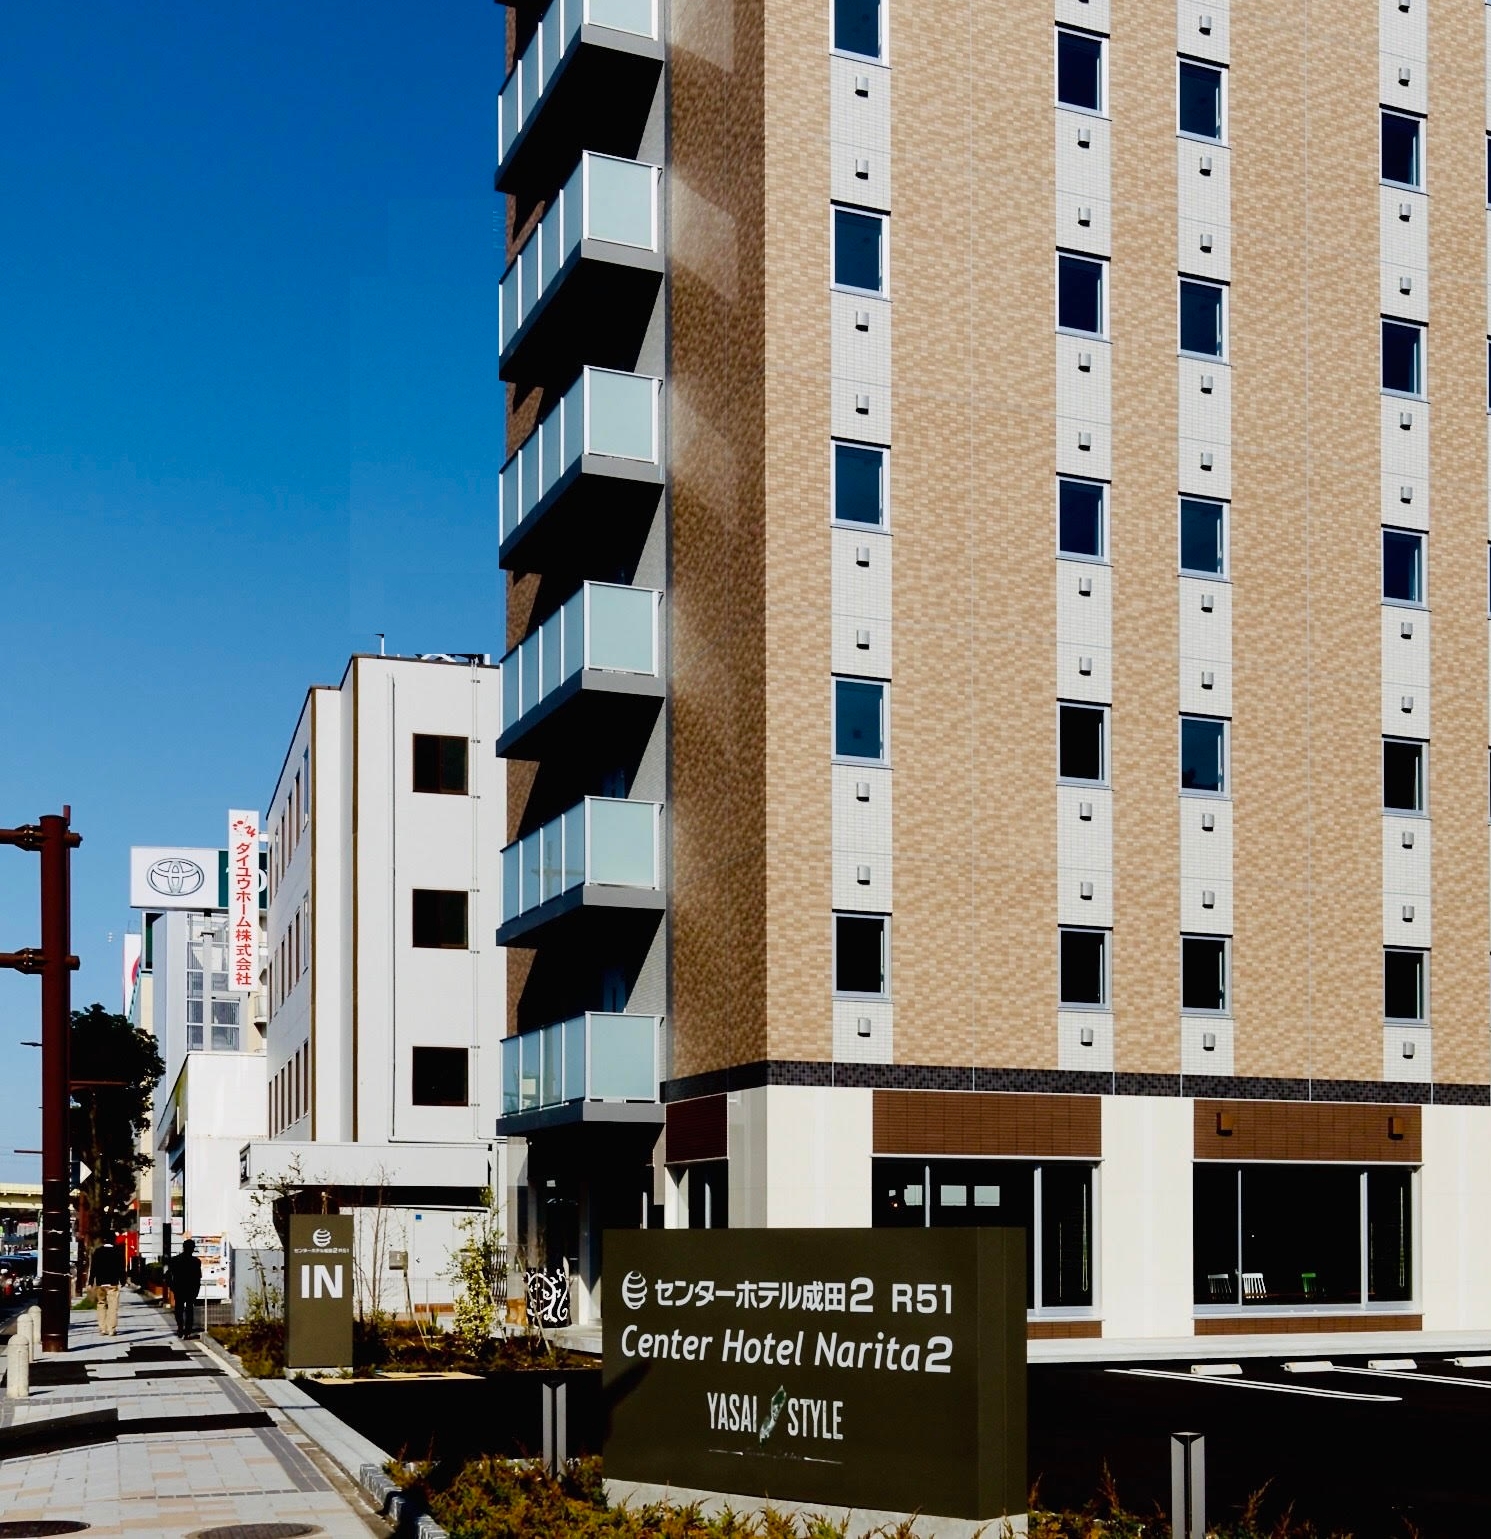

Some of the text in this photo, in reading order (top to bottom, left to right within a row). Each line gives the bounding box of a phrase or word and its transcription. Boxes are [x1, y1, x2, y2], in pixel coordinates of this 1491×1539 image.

[235, 842, 252, 985] ダイユウホーム株式会社
[301, 1265, 343, 1299] IN
[655, 1277, 952, 1314] センターホテル成田2 R51
[621, 1325, 953, 1374] Center Hotel Narita2
[707, 1392, 843, 1441] YASAI STYLE
